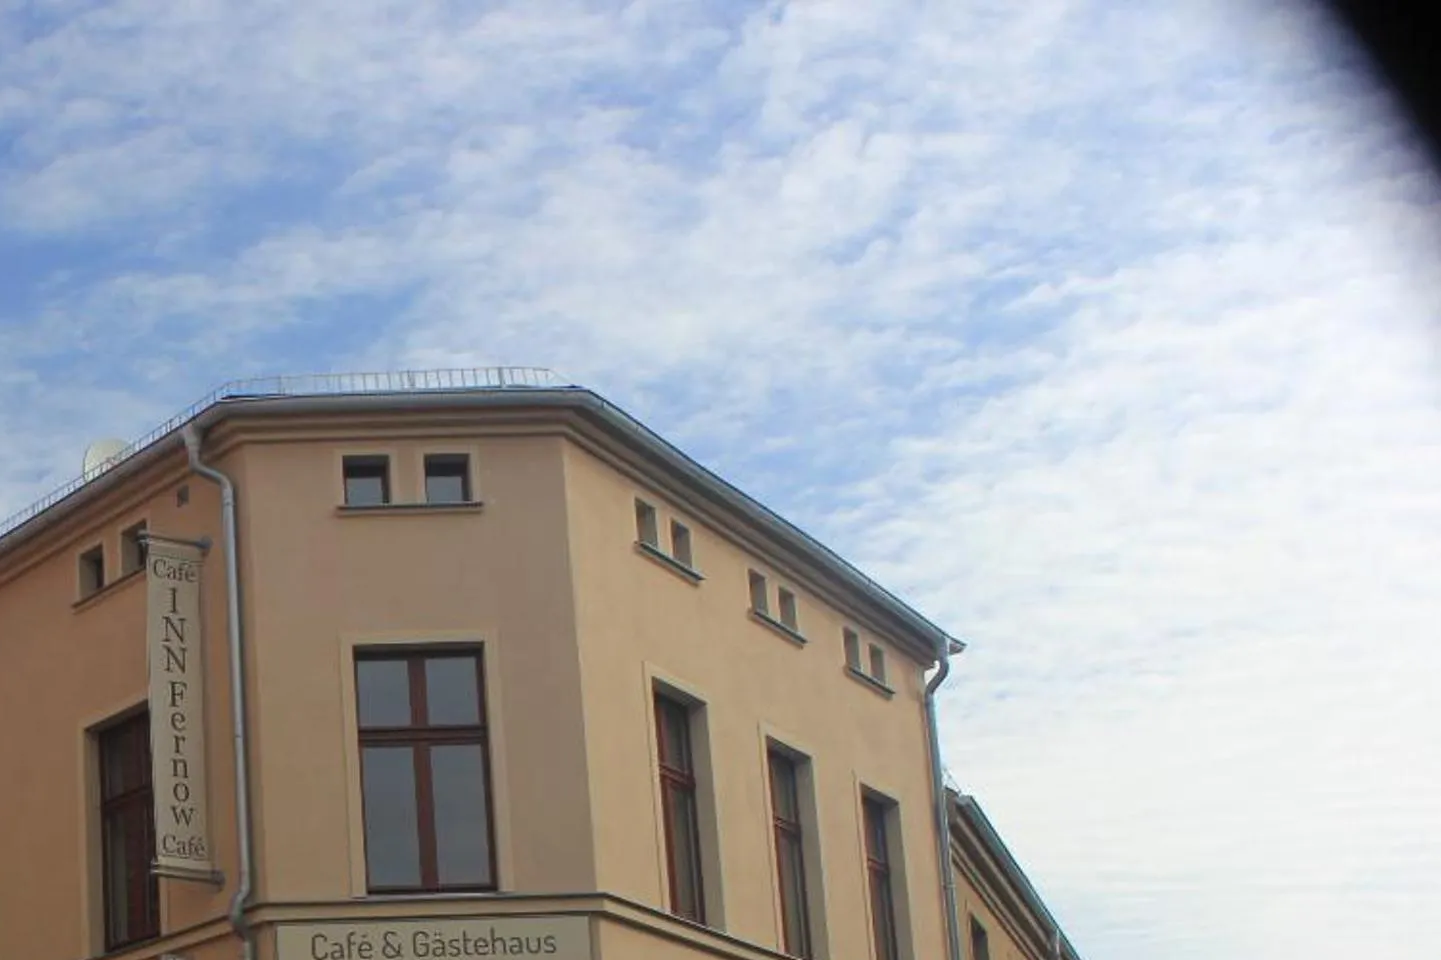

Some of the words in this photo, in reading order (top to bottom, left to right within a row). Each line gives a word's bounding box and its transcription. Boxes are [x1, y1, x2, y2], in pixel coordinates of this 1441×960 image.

[153, 558, 198, 583] Café
[162, 833, 206, 857] Café
[311, 931, 373, 960] Café
[382, 931, 402, 958] &
[412, 927, 557, 958] Gästehaus
